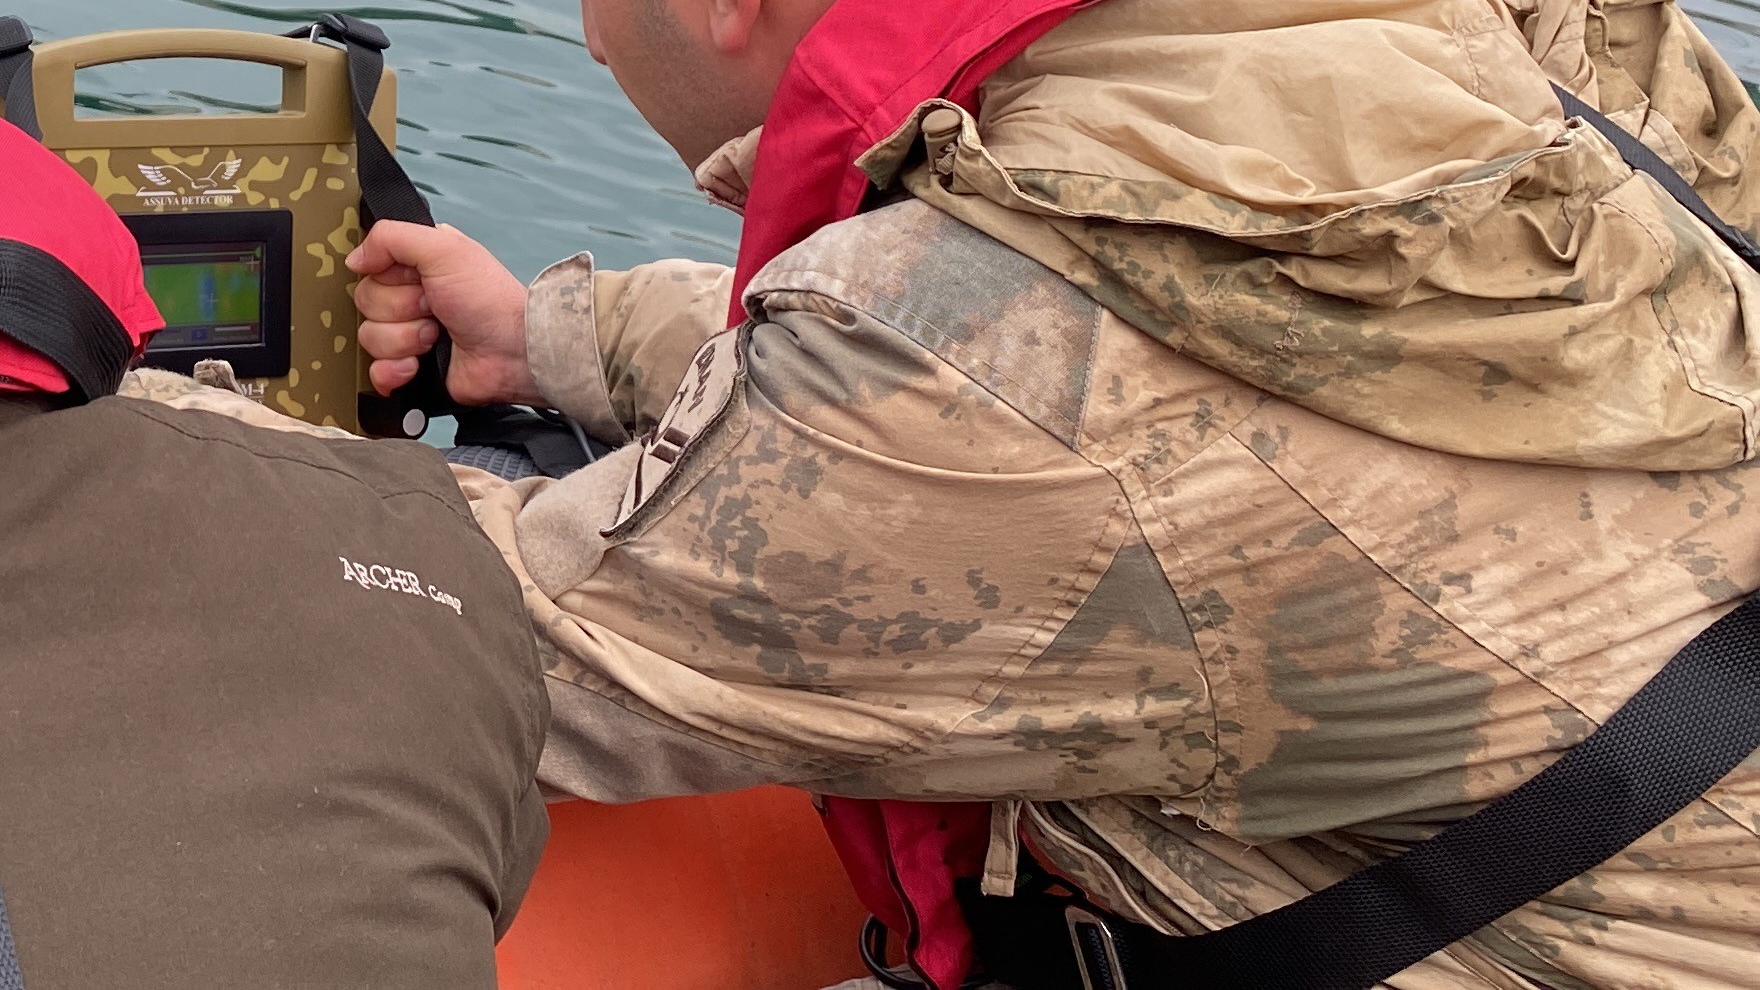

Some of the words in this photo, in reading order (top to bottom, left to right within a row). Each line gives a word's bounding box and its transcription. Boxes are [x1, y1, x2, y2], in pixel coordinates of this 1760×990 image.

[143, 196, 179, 206] ASSUVA
[181, 194, 234, 205] DETECTOR
[338, 556, 427, 597] ARCHER
